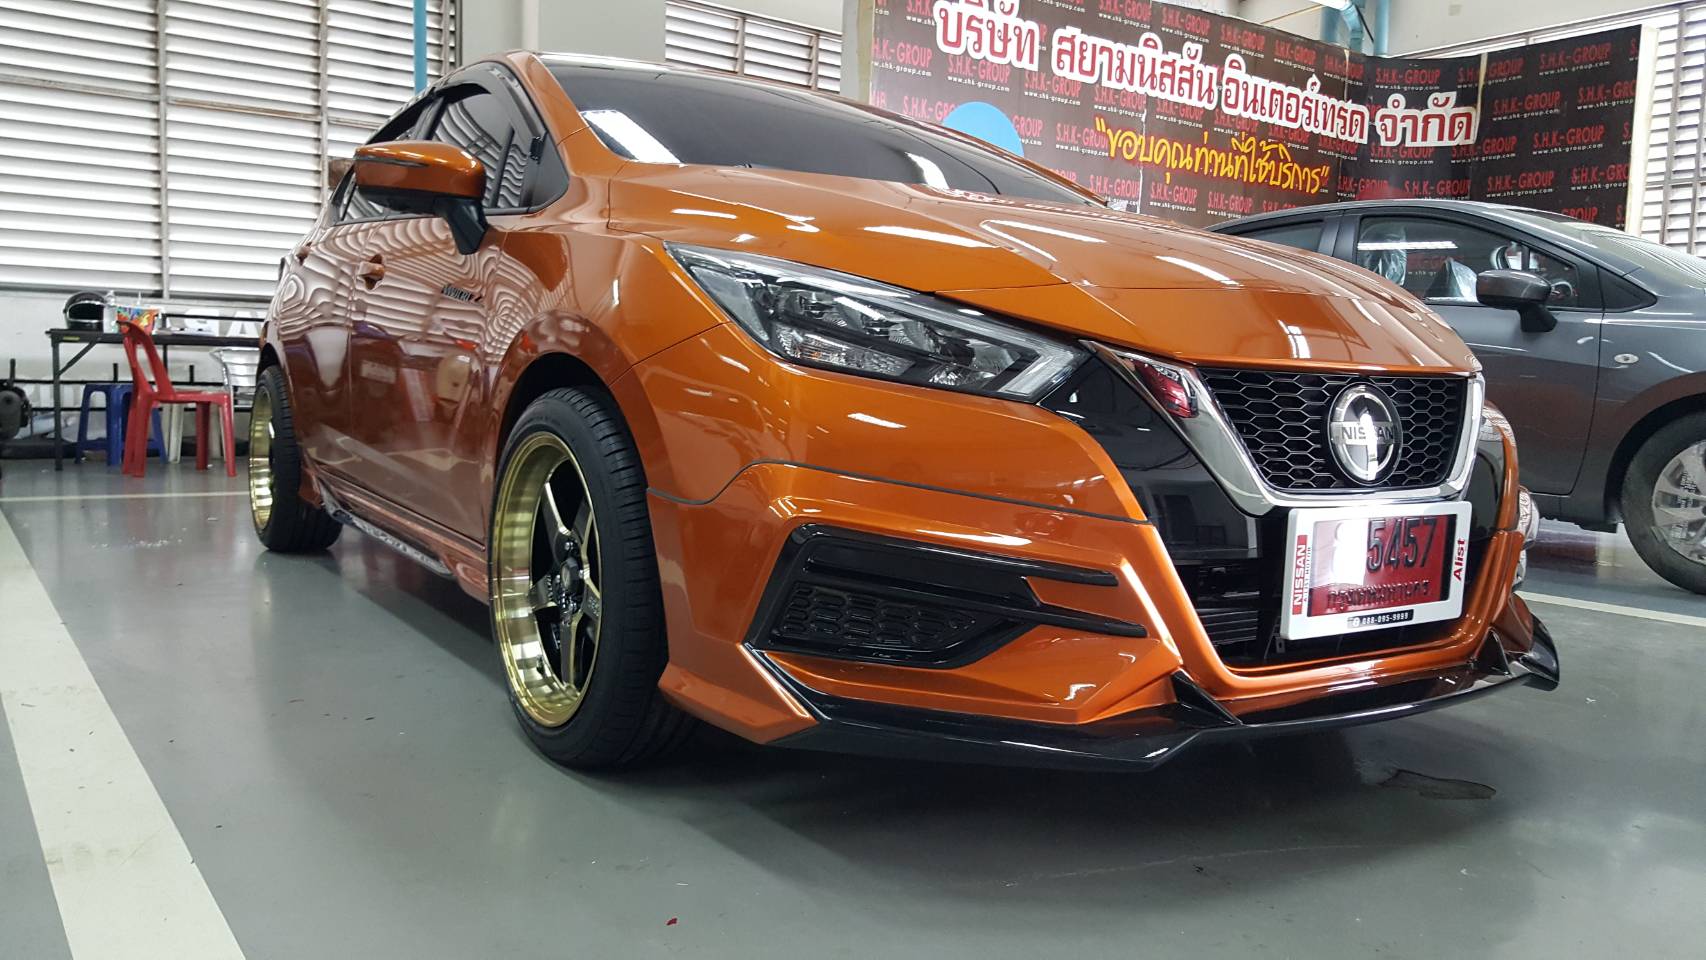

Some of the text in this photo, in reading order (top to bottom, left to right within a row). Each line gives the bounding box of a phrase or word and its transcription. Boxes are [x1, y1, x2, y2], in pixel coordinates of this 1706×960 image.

[1377, 93, 1474, 144] จำกัด
[1342, 426, 1393, 440] NISAN
[1366, 516, 1436, 573] 5457
[1453, 538, 1466, 581] Alist
[1293, 544, 1306, 606] NISSAN
